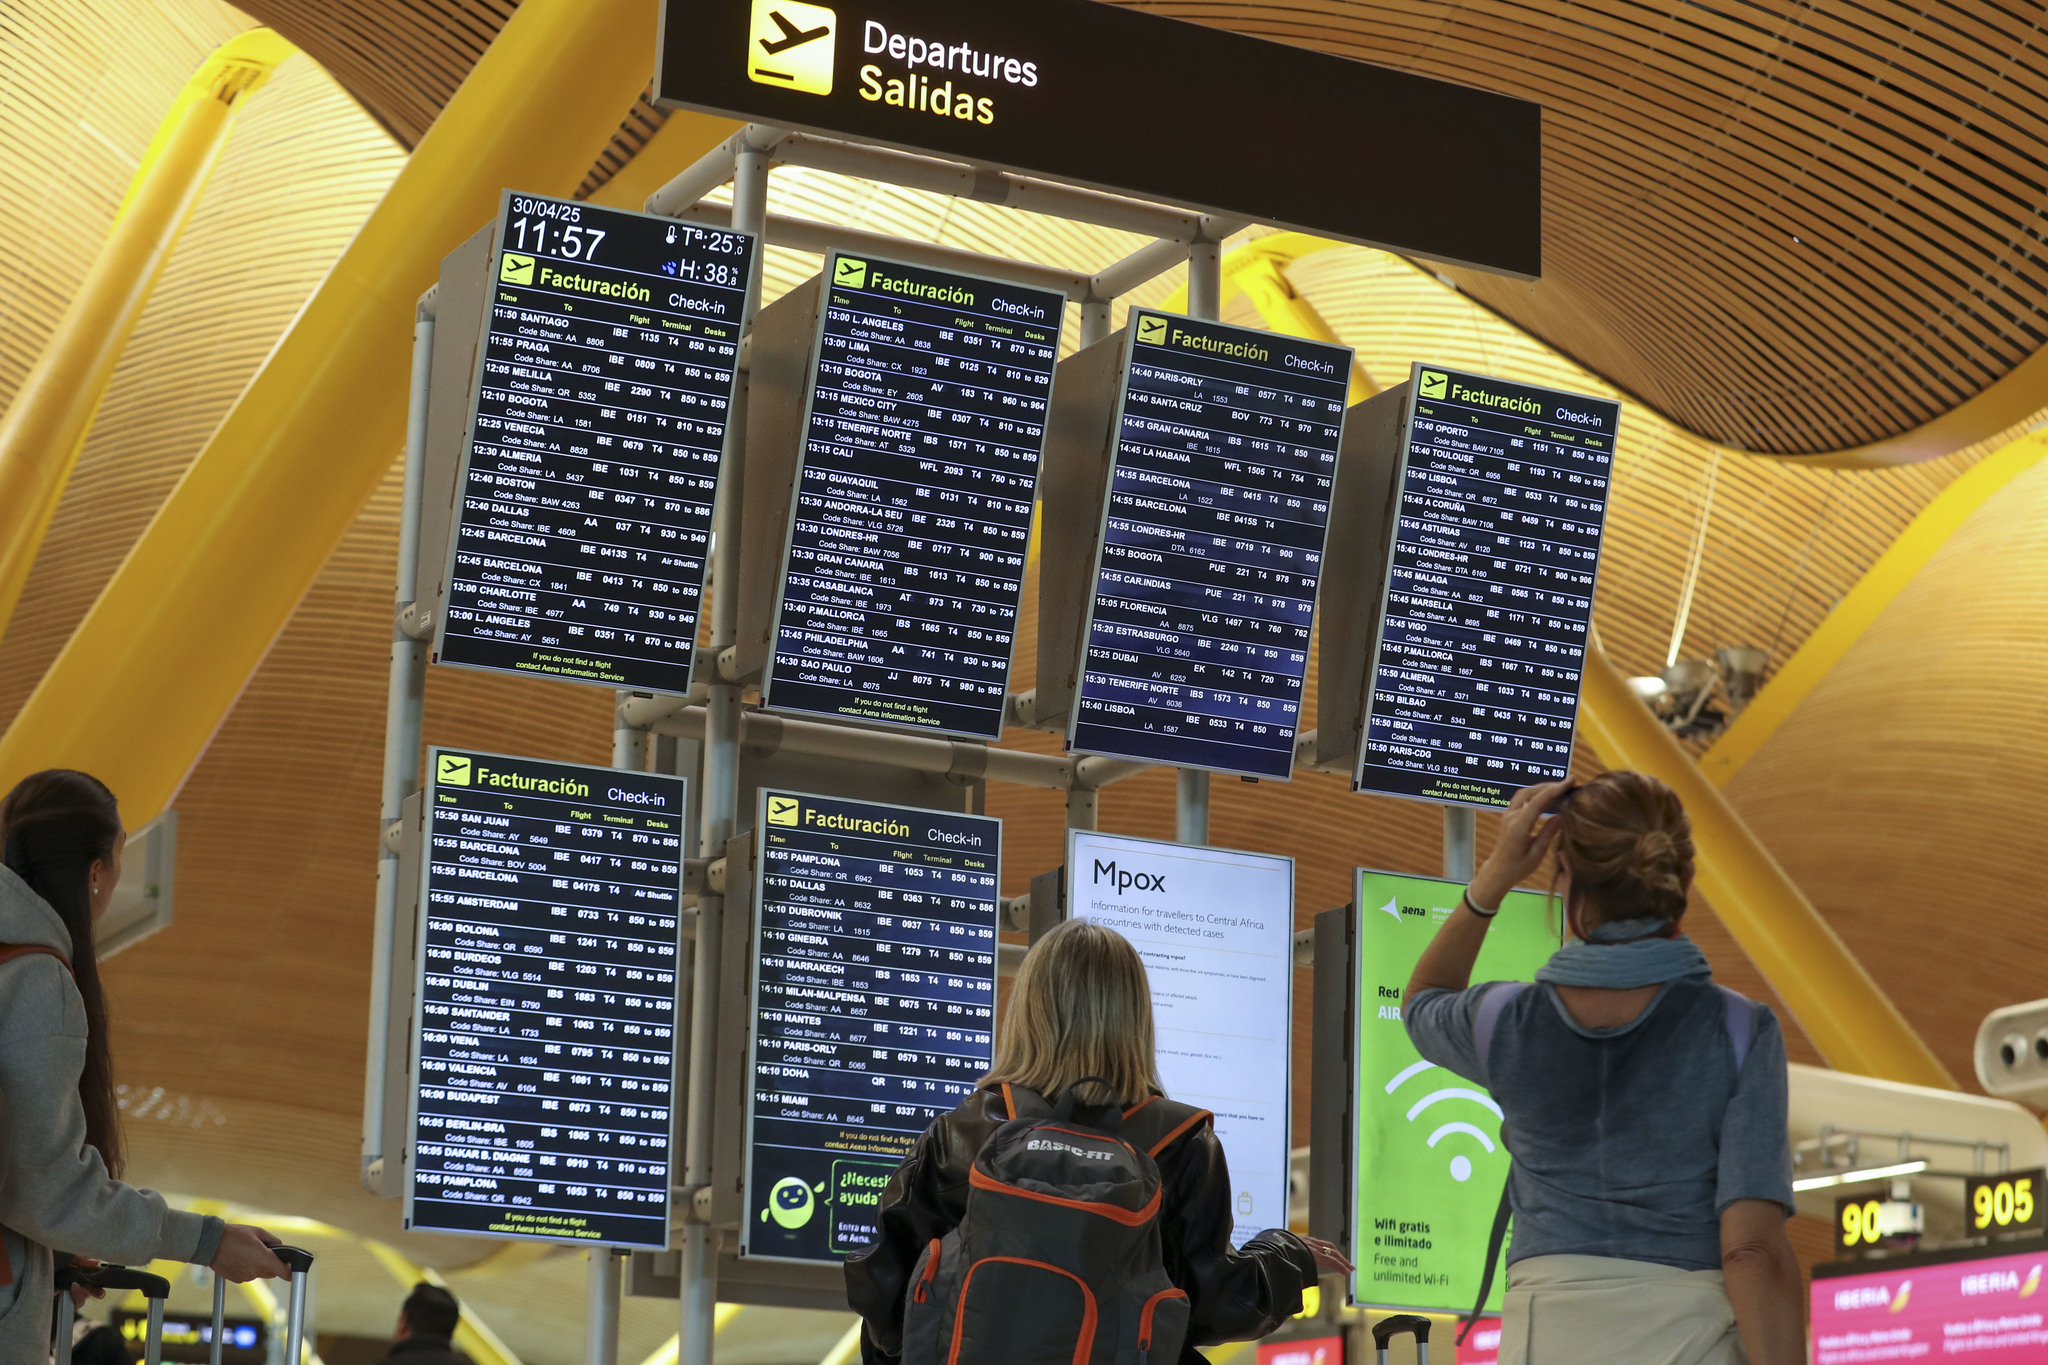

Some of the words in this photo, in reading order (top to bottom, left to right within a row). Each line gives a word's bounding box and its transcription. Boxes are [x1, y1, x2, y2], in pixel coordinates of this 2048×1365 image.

[864, 20, 1038, 87] Departures
[858, 64, 994, 124] Salidas
[513, 197, 580, 222] 30/04/25
[513, 217, 605, 260] 11:57
[540, 267, 649, 301] Facturación
[668, 293, 725, 314] Check-in
[871, 272, 974, 305] Facturación
[991, 298, 1044, 318] Check-in
[494, 308, 517, 319] 11:50
[520, 312, 569, 327] SANTIAGO
[612, 327, 628, 337] IBE
[640, 332, 659, 342] 1135
[668, 336, 678, 346] T4
[688, 340, 704, 350] 850
[718, 345, 733, 355] 859
[500, 292, 517, 302] Time
[629, 314, 649, 324] Flight
[661, 319, 691, 330] Terminal
[704, 327, 725, 336] Desks
[518, 326, 537, 335] Code
[539, 329, 562, 340] Share:
[565, 334, 576, 342] AA
[828, 310, 850, 321] 13:00
[852, 314, 860, 323] L.
[861, 316, 903, 331] ANGELES
[938, 330, 954, 340] IBE
[963, 335, 982, 345] 0351
[990, 339, 1000, 349] T4
[1010, 344, 1024, 353] 870
[1038, 349, 1052, 358] 886
[850, 328, 868, 337] Code
[870, 332, 892, 342] Share:
[1172, 329, 1267, 361] Facturación
[1284, 354, 1333, 373] Check-in
[1131, 366, 1152, 377] 14:40
[1154, 371, 1203, 386] PARIS-ORLY
[1235, 385, 1249, 395] IBE
[1258, 390, 1276, 400] 0577
[1284, 394, 1292, 403] T4
[1301, 398, 1315, 407] 850
[1327, 403, 1341, 412] 859
[1213, 395, 1227, 403] 1553
[1452, 384, 1541, 414] Facturación
[1556, 407, 1601, 426] Check-in
[1128, 392, 1148, 402] 14:40
[1150, 396, 1177, 408] SANTA
[1179, 401, 1202, 412] CRUZ
[1231, 411, 1249, 420] BOV
[1259, 415, 1272, 425] 773
[1280, 419, 1289, 428] T4
[1298, 423, 1311, 432] 970
[1324, 428, 1337, 437] 974
[1414, 420, 1433, 430] 15:40
[1435, 424, 1468, 437] OPORTO
[1510, 438, 1523, 447] IBE
[1532, 442, 1548, 452] 1151
[1555, 446, 1564, 455] T4
[1572, 450, 1585, 459] 850
[1596, 454, 1608, 463] 859
[1400, 519, 1419, 529] 15:45
[1421, 523, 1460, 536] ASTURIAS
[1497, 536, 1510, 545] IBE
[1519, 540, 1535, 549] 1123
[1542, 543, 1550, 552] T4
[1558, 547, 1571, 555] 850
[1582, 551, 1594, 559] 859
[561, 666, 597, 677] Information
[600, 672, 624, 681] Service
[595, 660, 611, 668] flight
[477, 768, 588, 796] Facturación
[607, 787, 665, 806] Check-in
[434, 810, 459, 820] 15:50
[461, 813, 482, 823] SAN
[483, 816, 509, 826] JUAN
[555, 824, 571, 834] IBE
[581, 827, 603, 837] 0379
[610, 831, 622, 840] T4
[632, 834, 648, 843] 870
[662, 837, 678, 846] 886
[805, 809, 909, 837] Facturación
[928, 828, 981, 846] Check-in
[766, 850, 788, 860] 16:05
[790, 852, 840, 866] PAMPLONA
[879, 864, 893, 873] IBE
[904, 867, 923, 876] 1053
[931, 870, 941, 878] T4
[951, 873, 966, 882] 850
[980, 876, 994, 885] 859
[1093, 858, 1165, 895] Mpox
[1091, 900, 1139, 914] Information
[1142, 906, 1154, 915] for
[1156, 909, 1193, 921] travellers
[1195, 914, 1204, 922] to
[1206, 914, 1237, 926] Central
[1239, 918, 1264, 929] Africa
[1102, 918, 1141, 928] countries
[1143, 921, 1161, 930] with
[1164, 923, 1200, 936] detected
[1202, 930, 1224, 938] cases
[1402, 906, 1426, 916] aena
[1378, 985, 1399, 998] Red
[1026, 1140, 1114, 1160] BASIC-FIT
[1974, 1178, 2034, 1229] 905
[1374, 1236, 1381, 1246] e
[1384, 1235, 1432, 1250] ilimitado
[1375, 1218, 1396, 1230] Wifi
[1400, 1222, 1430, 1234] gratis
[1374, 1253, 1396, 1266] Free
[1399, 1256, 1418, 1268] and
[1374, 1270, 1421, 1284] unlimited
[1424, 1273, 1449, 1286] Wi-Fi
[1834, 1286, 1890, 1311] IBERIA
[1961, 1270, 2019, 1295] IBERIA
